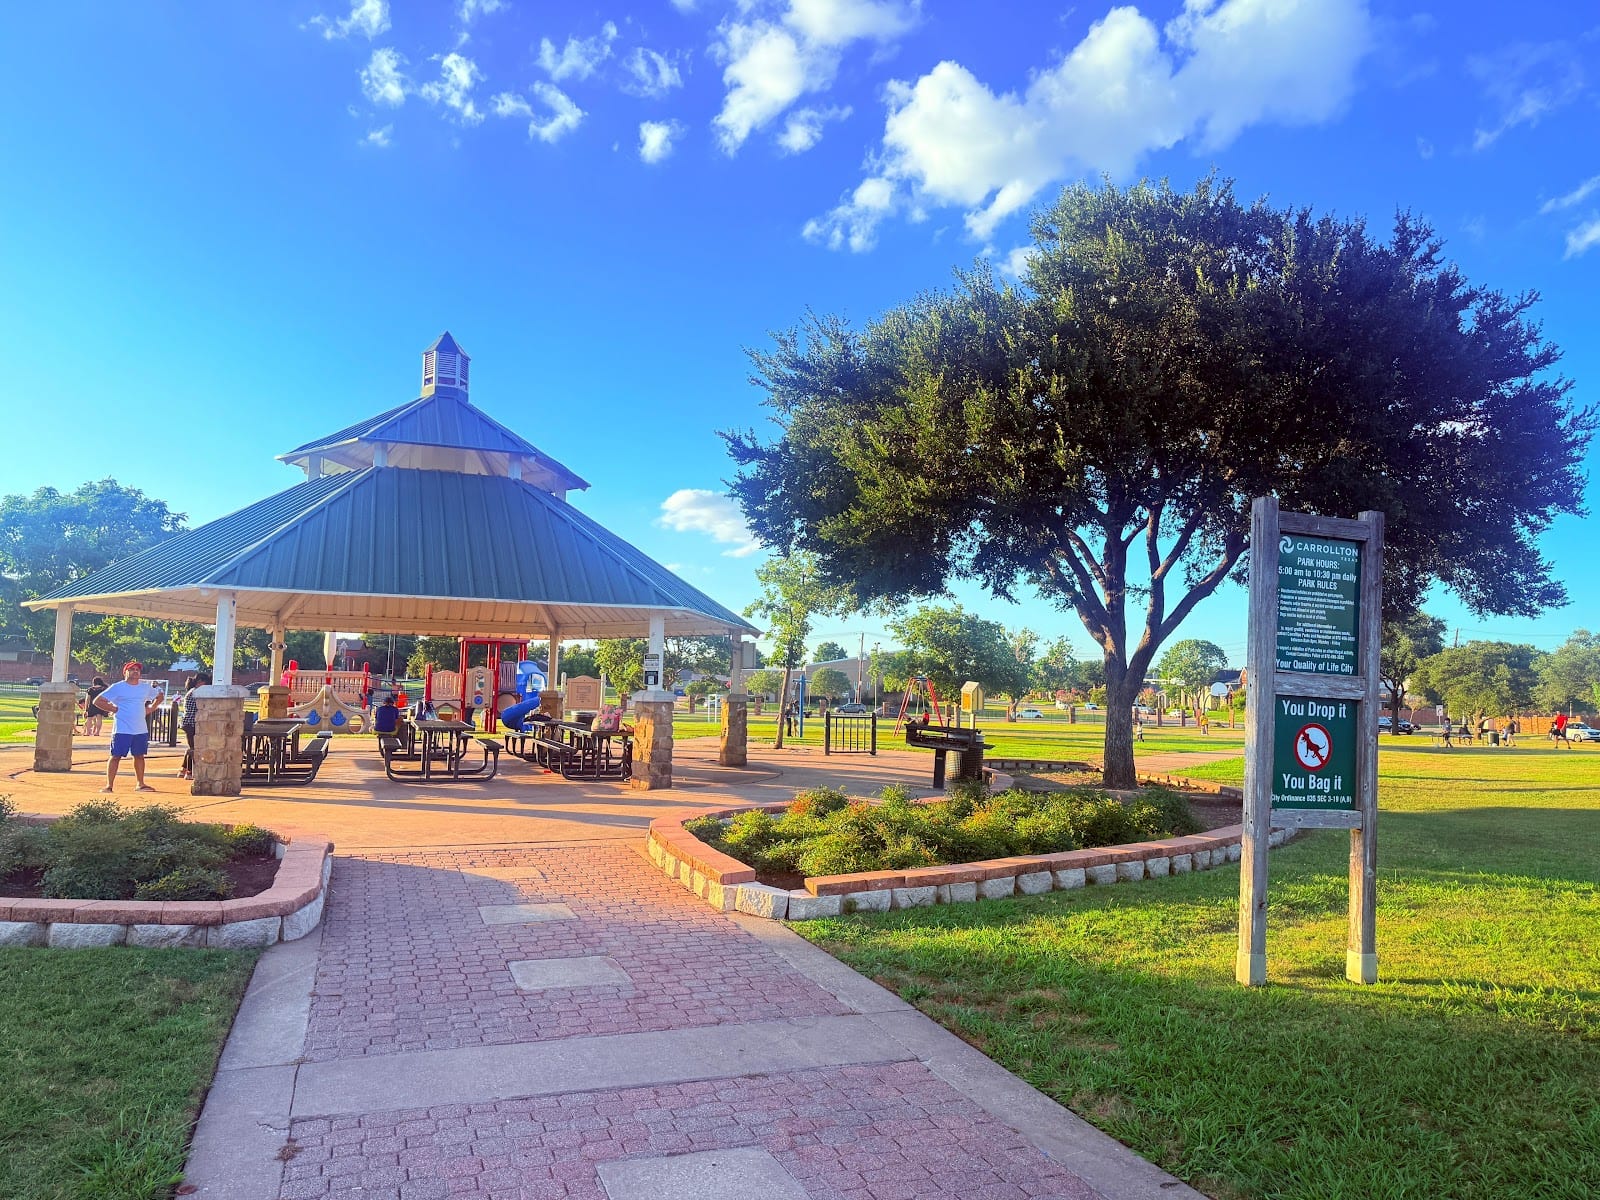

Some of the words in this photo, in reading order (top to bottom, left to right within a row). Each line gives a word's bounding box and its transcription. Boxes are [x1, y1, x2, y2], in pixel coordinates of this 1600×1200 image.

[1296, 542, 1358, 556] CARROLLTON
[1297, 557, 1314, 566] PARK
[1316, 559, 1340, 569] HOURS:
[1278, 566, 1292, 574] 5:00
[1305, 569, 1311, 577] to
[1313, 569, 1330, 578] 10:30
[1342, 573, 1356, 583] daily
[1298, 579, 1315, 588] PARK
[1317, 581, 1337, 590] RULES
[1276, 659, 1291, 668] Your
[1293, 660, 1317, 672] Quality
[1318, 662, 1325, 670] of
[1326, 662, 1339, 671] Life
[1340, 663, 1353, 674] City
[1282, 700, 1304, 716] You
[1308, 702, 1335, 720] Drop
[1339, 704, 1346, 718] it
[1282, 774, 1304, 789] You
[1309, 774, 1330, 793] Bag
[1334, 775, 1342, 790] it
